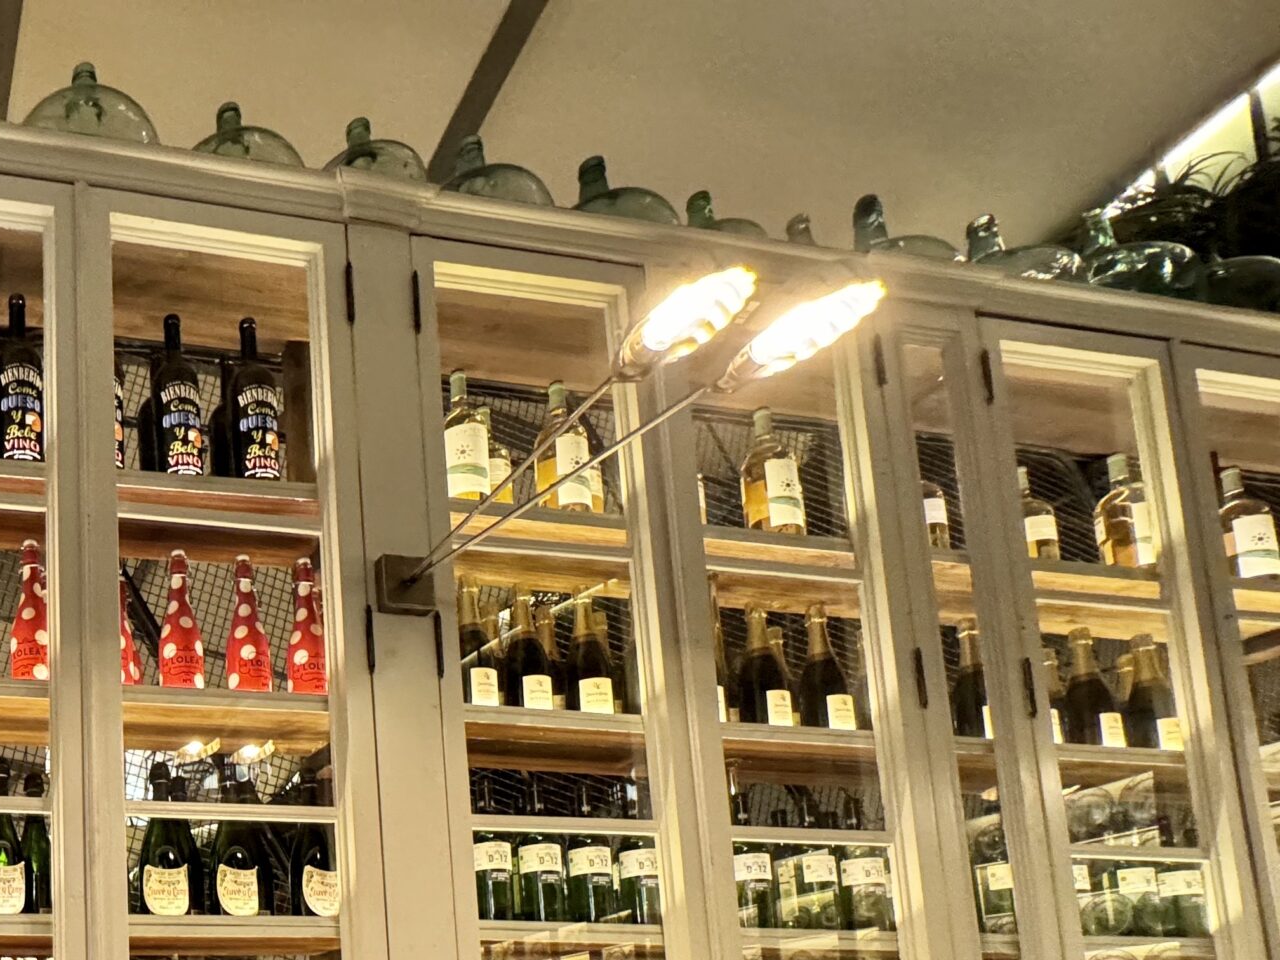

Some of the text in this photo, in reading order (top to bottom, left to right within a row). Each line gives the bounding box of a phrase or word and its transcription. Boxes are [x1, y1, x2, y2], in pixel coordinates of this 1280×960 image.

[8, 383, 38, 398] Come
[1, 394, 41, 413] QUESO
[170, 399, 198, 414] Come
[162, 411, 200, 429] QUESO
[6, 425, 37, 441] Bebe
[4, 438, 40, 452] VINO
[169, 441, 198, 456] Bebe
[246, 444, 276, 459] Bebe
[168, 454, 202, 468] VINO
[245, 457, 279, 469] VINO
[538, 856, 559, 865] D-12
[588, 858, 608, 867] D-12
